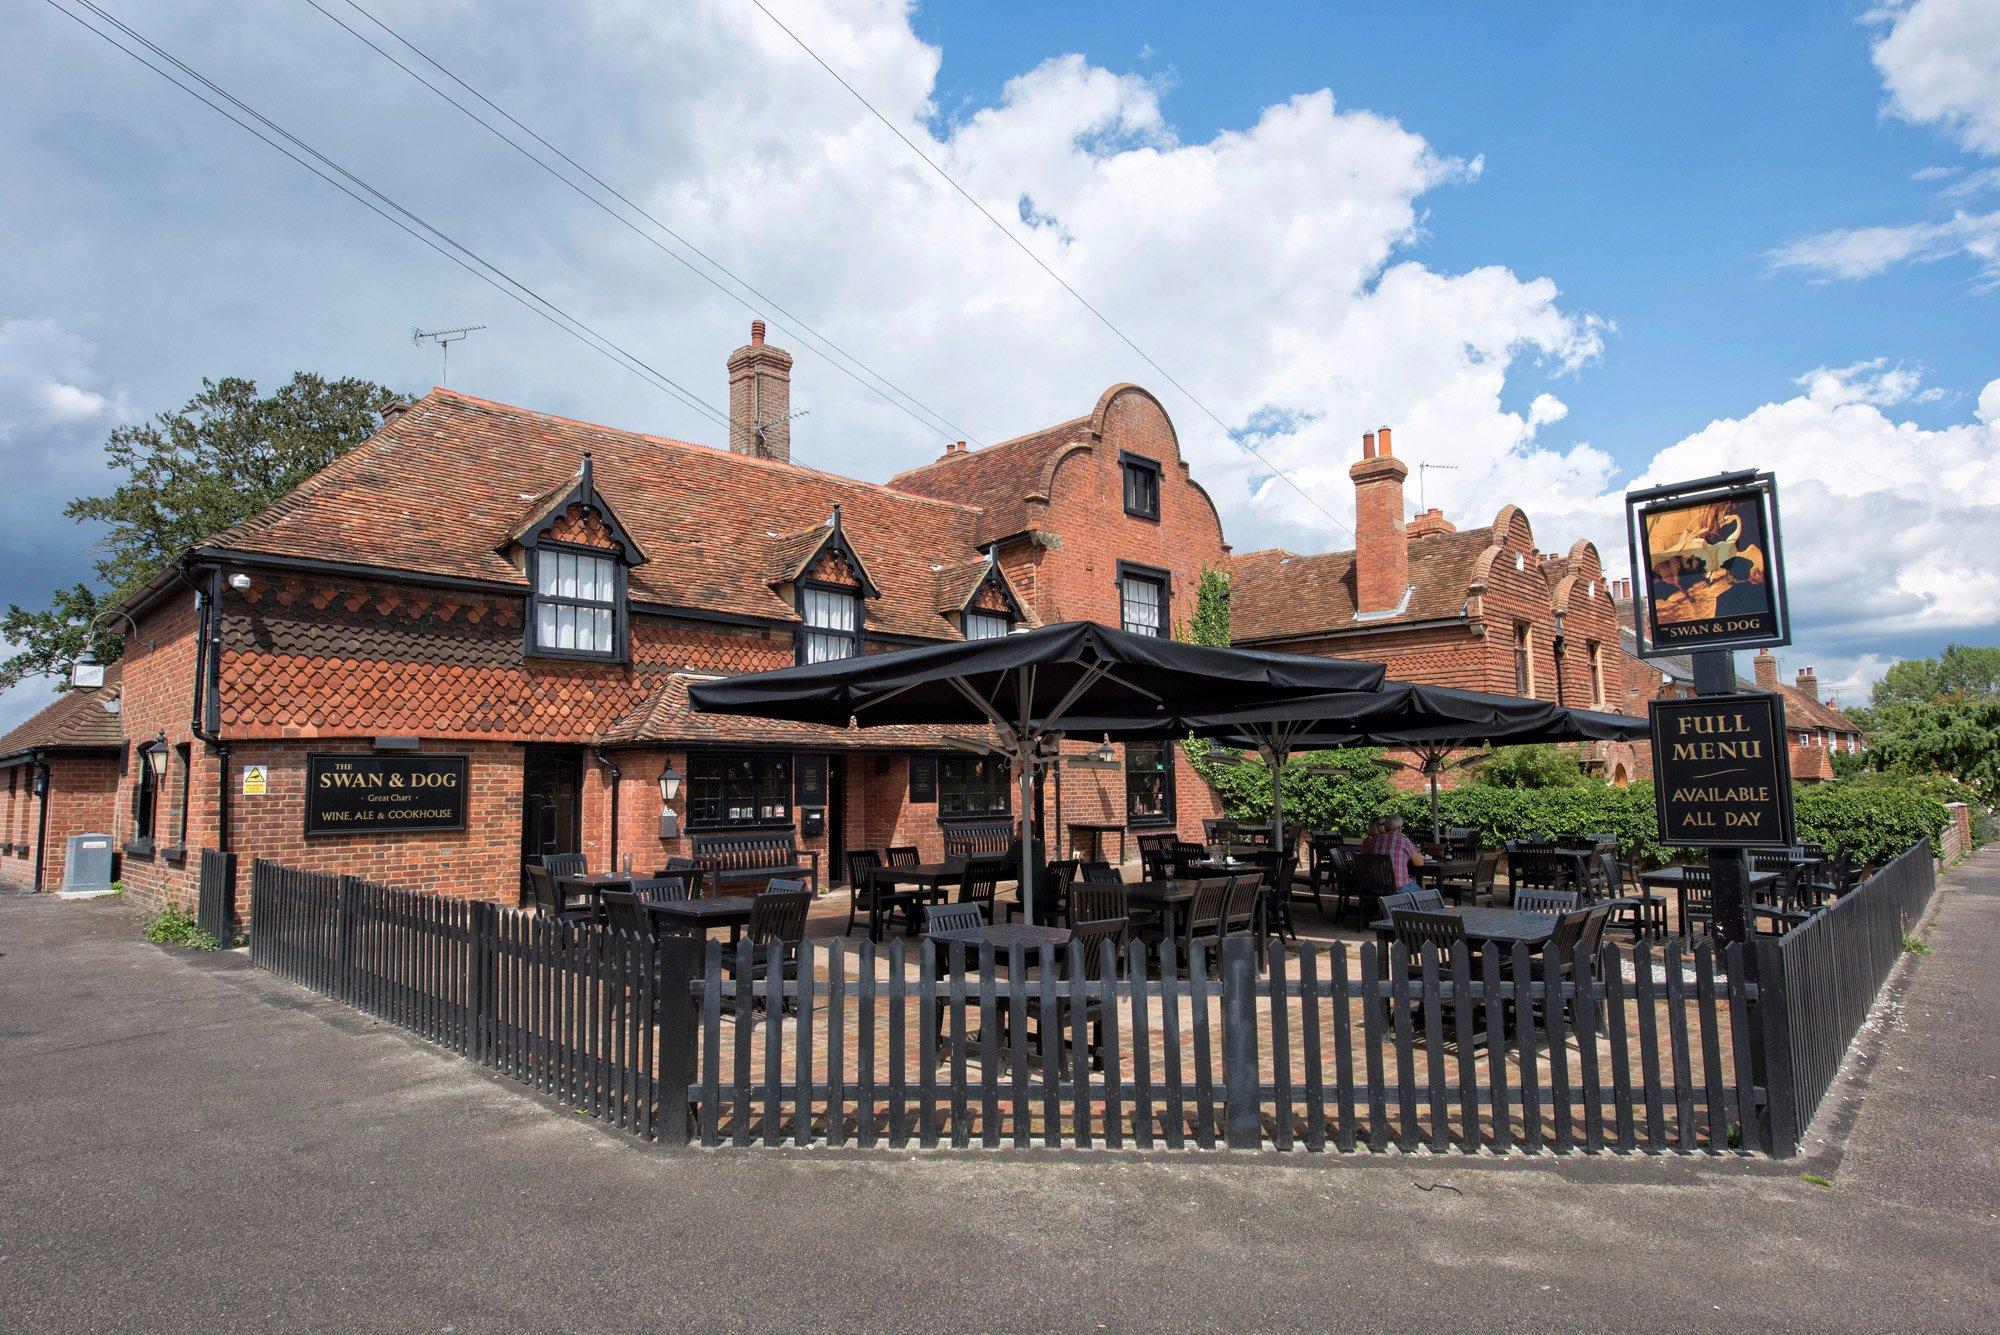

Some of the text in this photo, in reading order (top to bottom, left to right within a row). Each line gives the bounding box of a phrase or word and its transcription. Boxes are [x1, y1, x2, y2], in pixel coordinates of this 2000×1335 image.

[1670, 624, 1710, 638] SWAN
[1712, 623, 1724, 633] &
[1727, 618, 1761, 632] DOG
[1677, 714, 1750, 735] FULL
[1672, 740, 1762, 761] MENU
[335, 763, 353, 771] THE
[320, 772, 457, 788] SWAN & DOG
[367, 793, 412, 802] Great Chart
[1672, 787, 1770, 802] AVAILABLE
[322, 809, 452, 822] WINE, ALE & COOKHOUSE
[1682, 812, 1762, 826] ALL DAY
